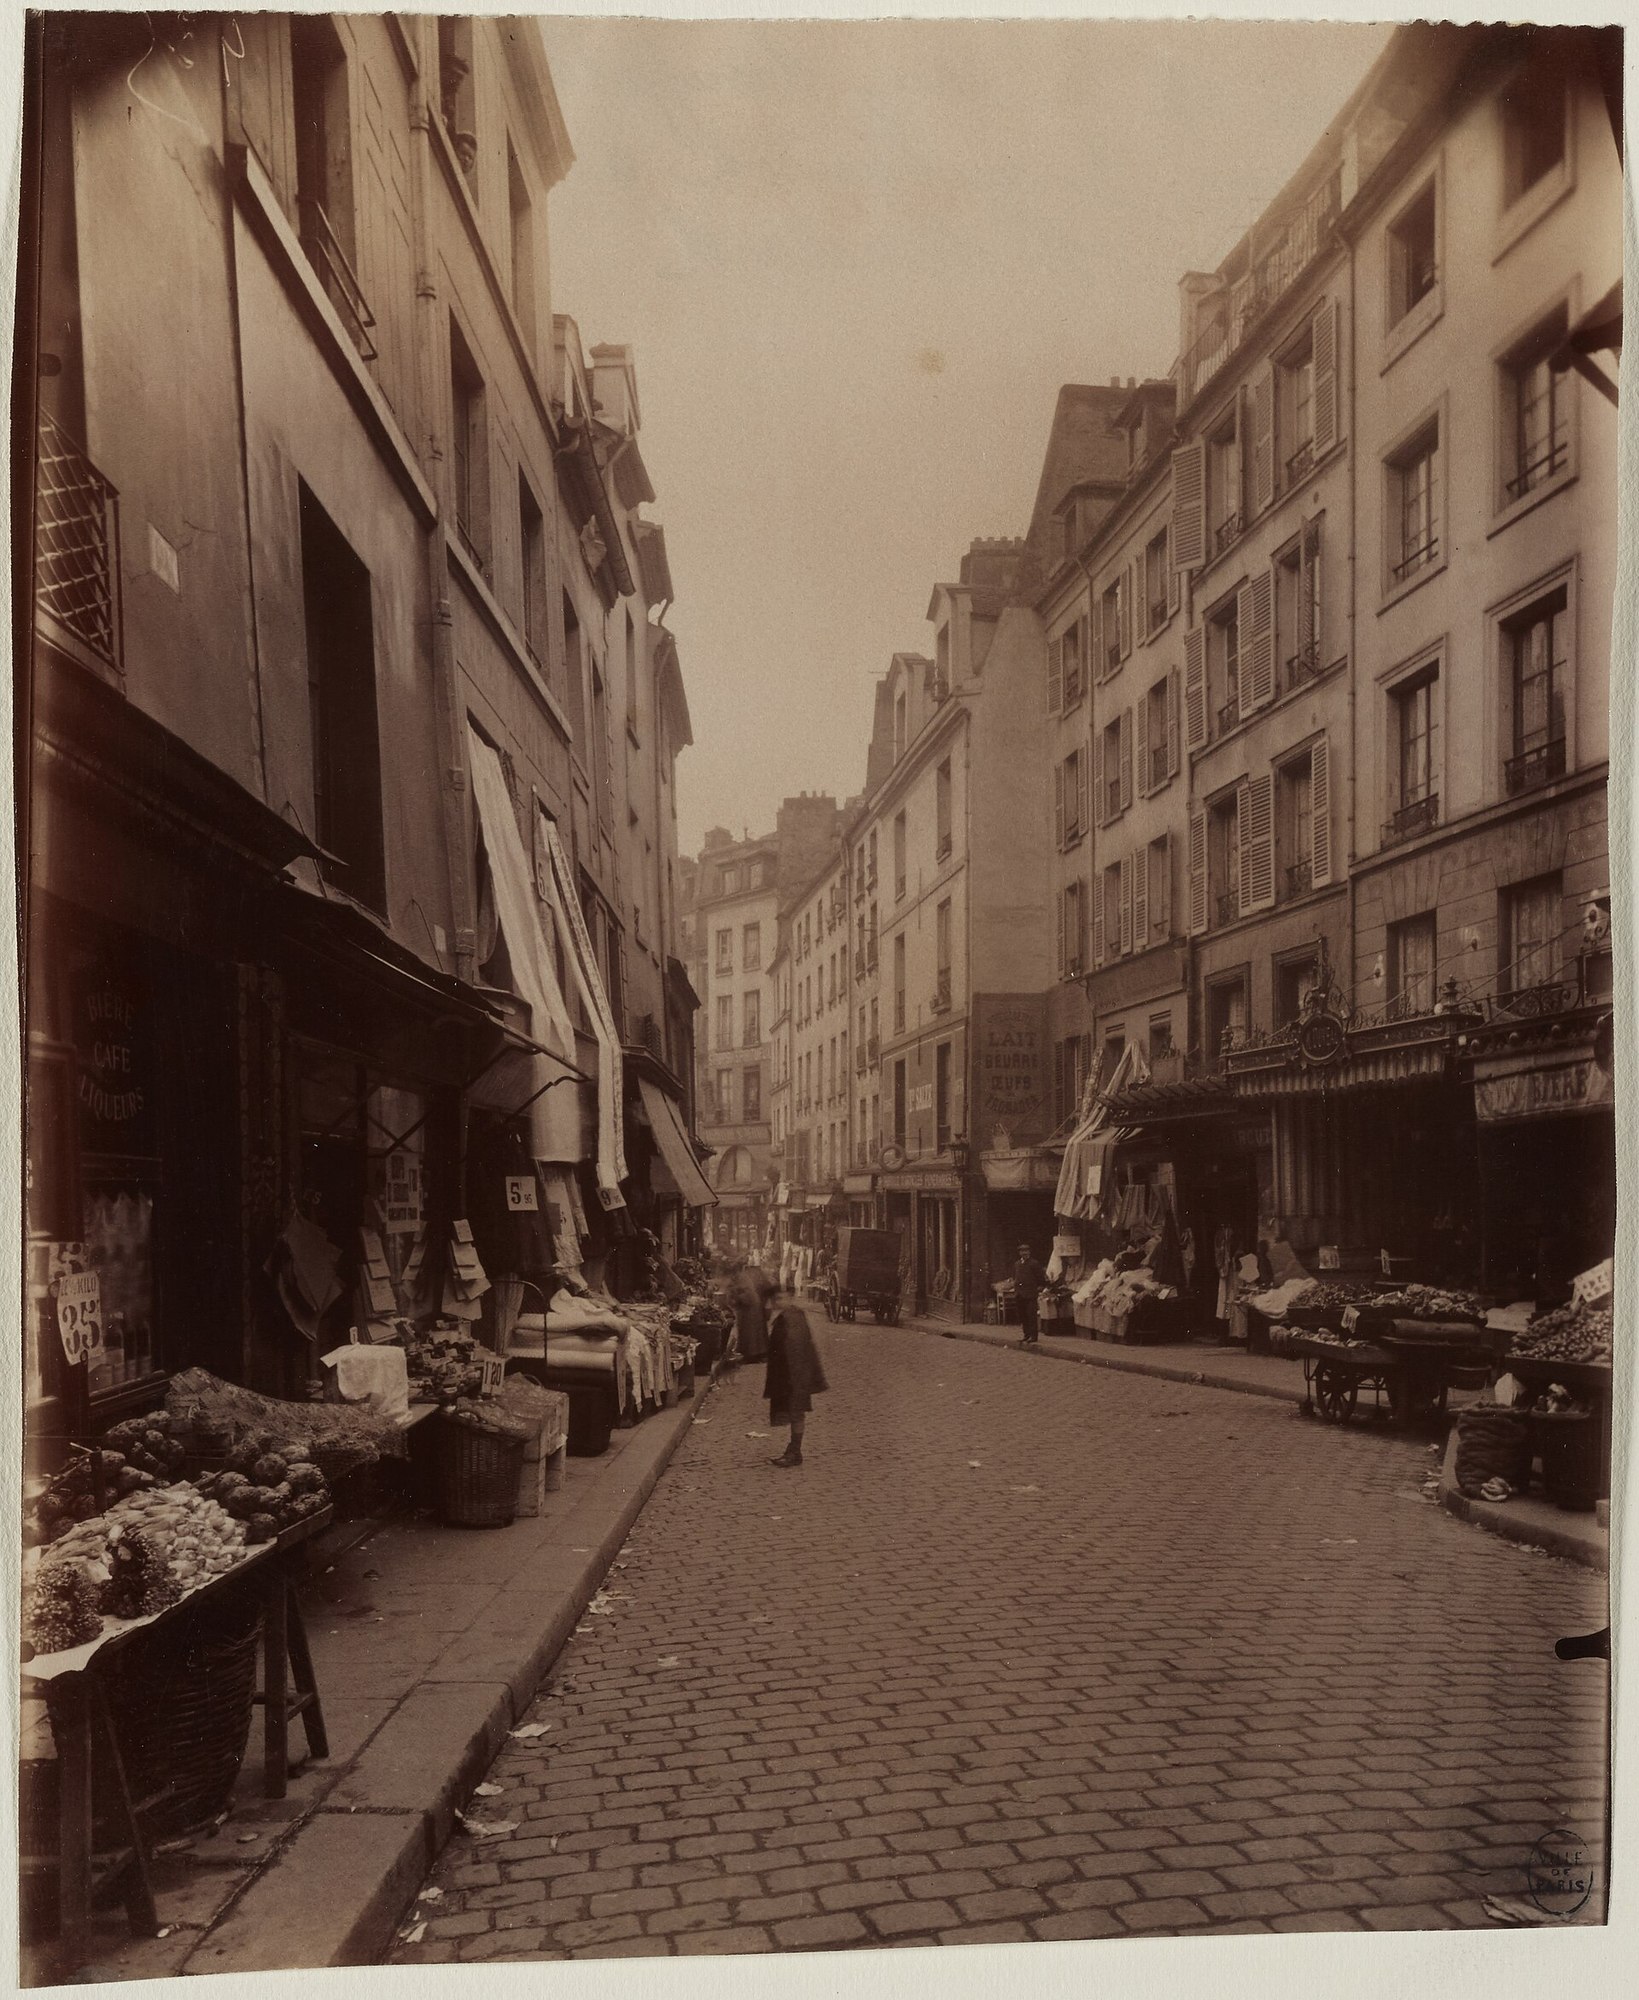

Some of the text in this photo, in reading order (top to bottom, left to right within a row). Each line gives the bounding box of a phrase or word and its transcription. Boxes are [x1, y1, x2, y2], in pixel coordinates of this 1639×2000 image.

[988, 1032, 1037, 1047] LAIT
[80, 1074, 145, 1121] LIQUEURS
[510, 1182, 521, 1204] 5
